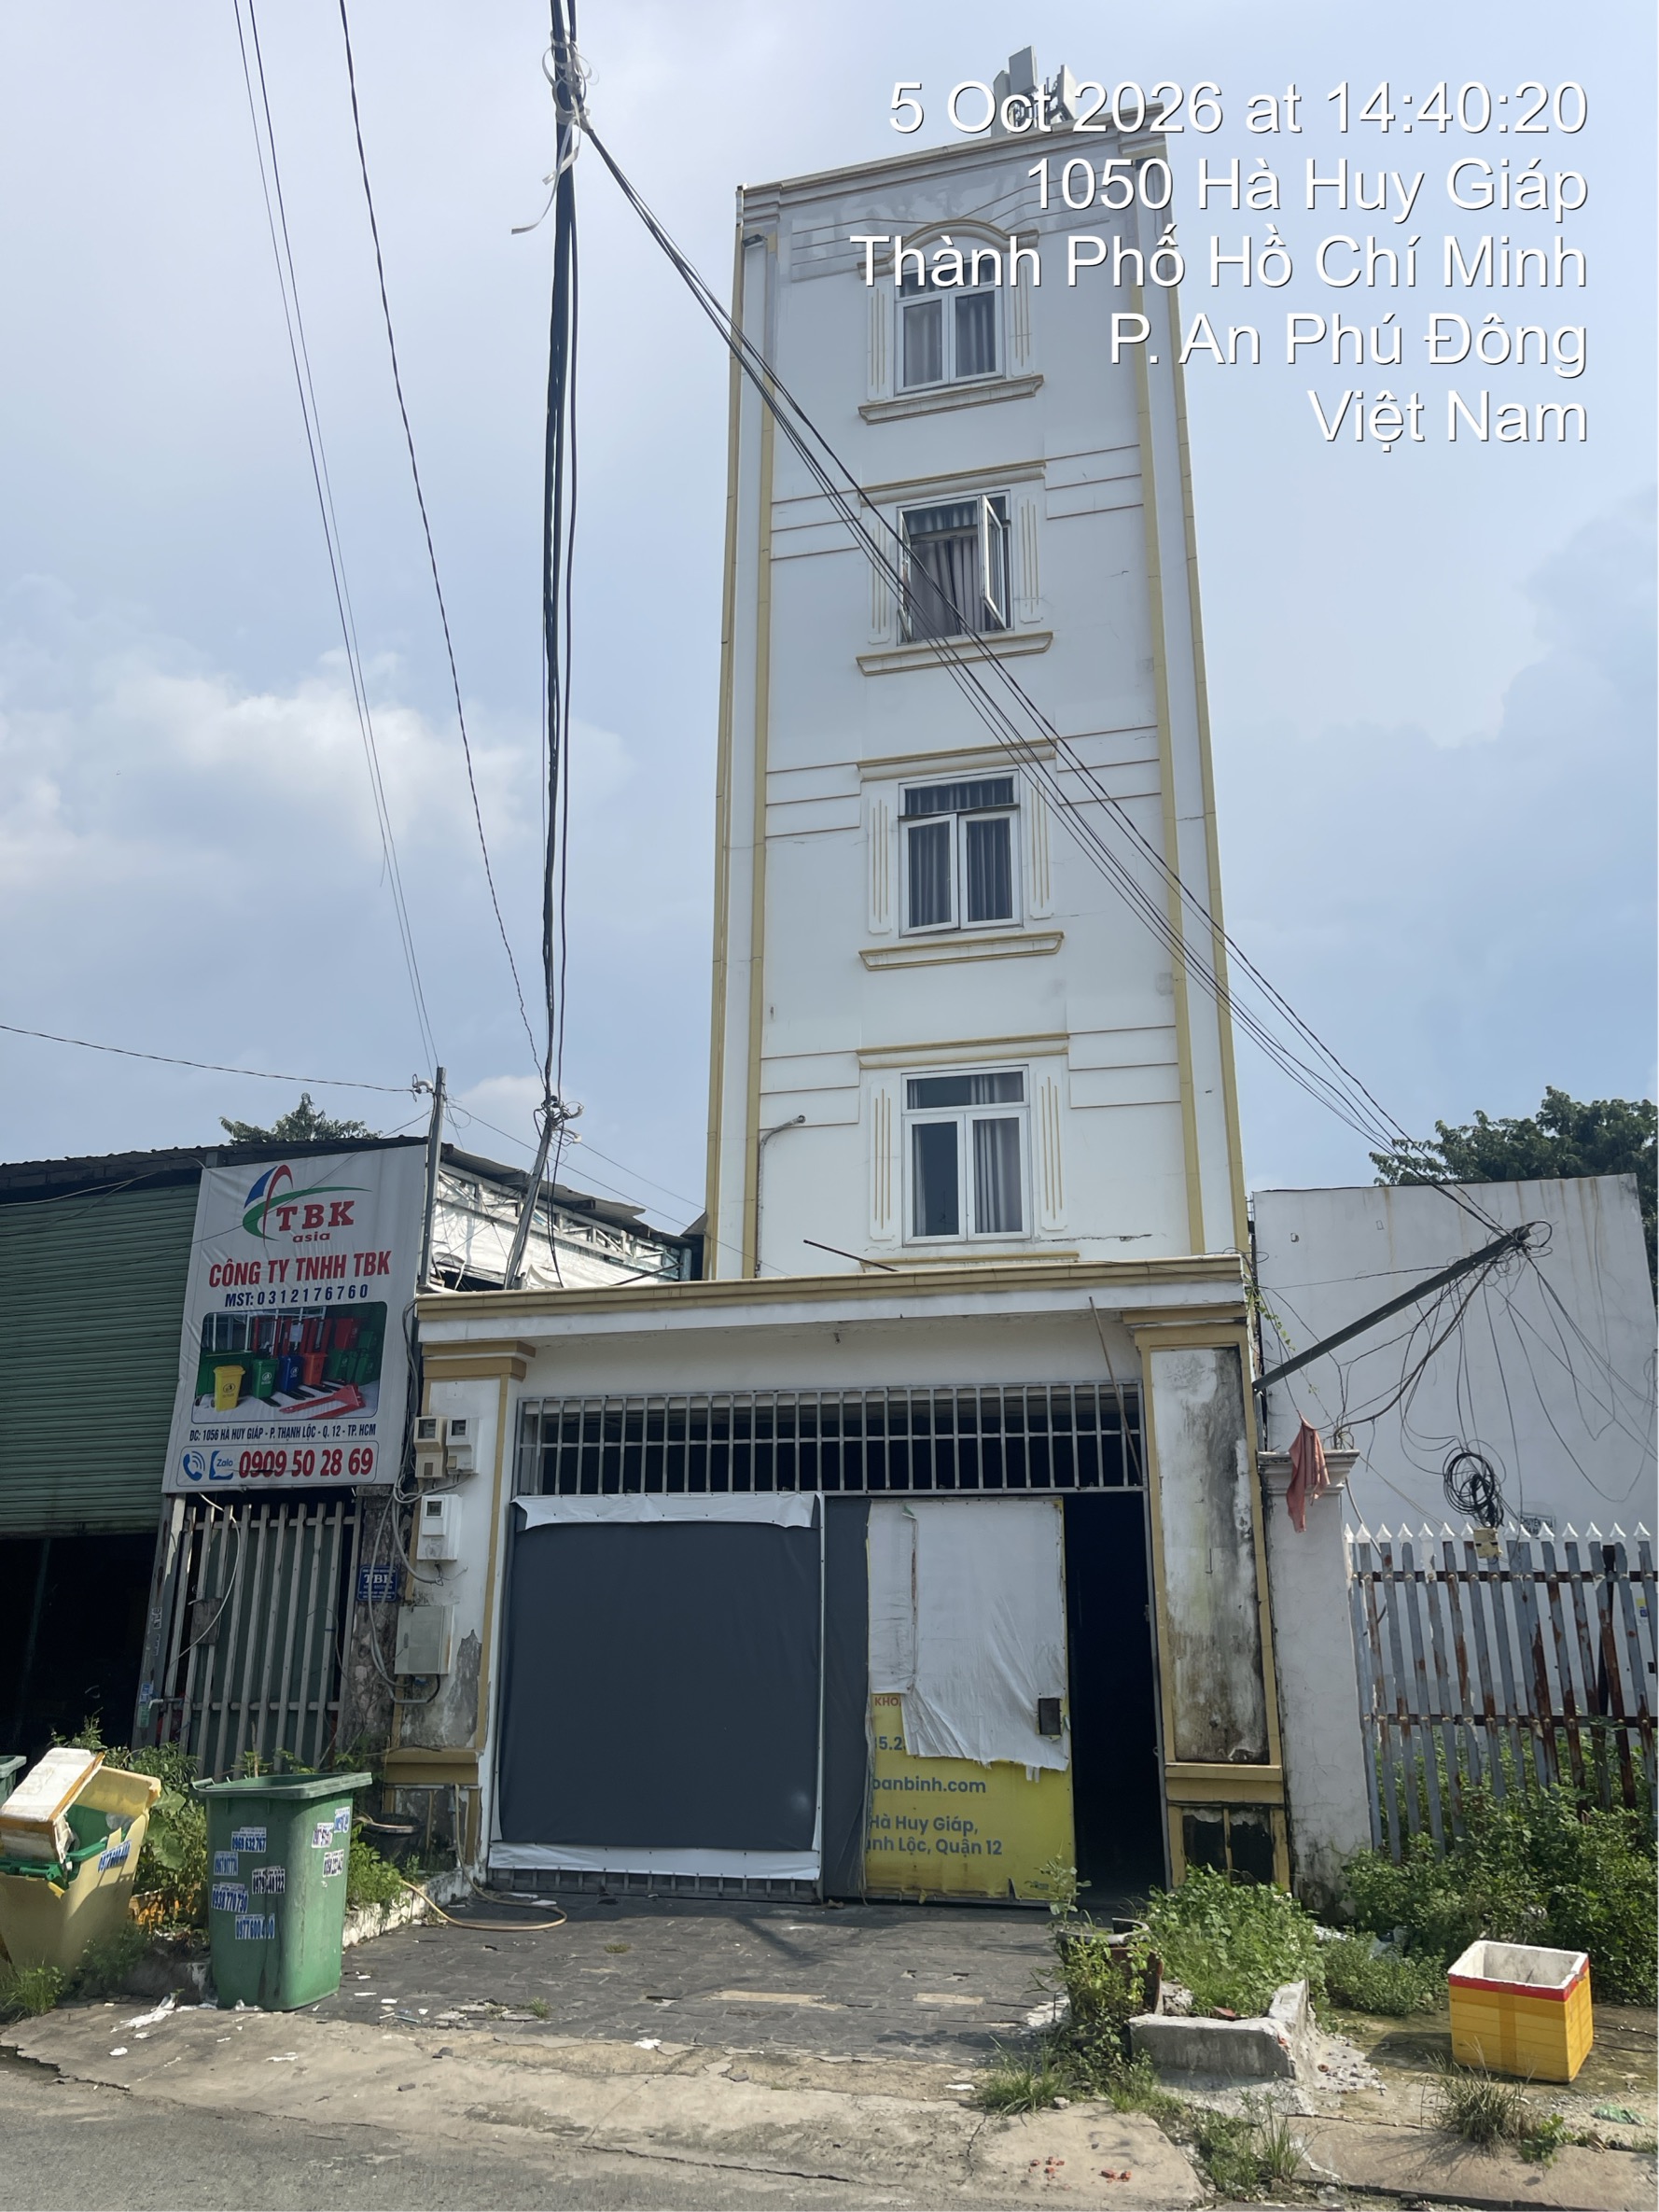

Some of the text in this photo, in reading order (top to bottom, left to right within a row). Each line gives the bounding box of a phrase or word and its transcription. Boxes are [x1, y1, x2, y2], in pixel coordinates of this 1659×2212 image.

[276, 1200, 355, 1231] TBK
[292, 1231, 330, 1243] asia
[209, 1251, 392, 1288] CÔNG TY TNHH TBK
[225, 1292, 254, 1307] MST:
[220, 1426, 230, 1441] HÀ
[231, 1428, 245, 1440] HUY
[247, 1425, 264, 1439] GIÁP
[278, 1426, 301, 1441] THẠNH
[302, 1423, 316, 1440] LỘC
[322, 1425, 329, 1438] Q.
[332, 1424, 342, 1437] 12
[347, 1424, 357, 1436] TP.
[359, 1423, 376, 1435] HCM
[216, 1448, 373, 1478] Zalo 0909 50 28 69
[874, 1696, 902, 1707] KHO
[870, 1813, 979, 1837] Hà Huy Giáp,
[899, 1836, 931, 1855] Lộc,
[936, 1838, 983, 1857] Quận
[985, 1840, 1002, 1855] 12
